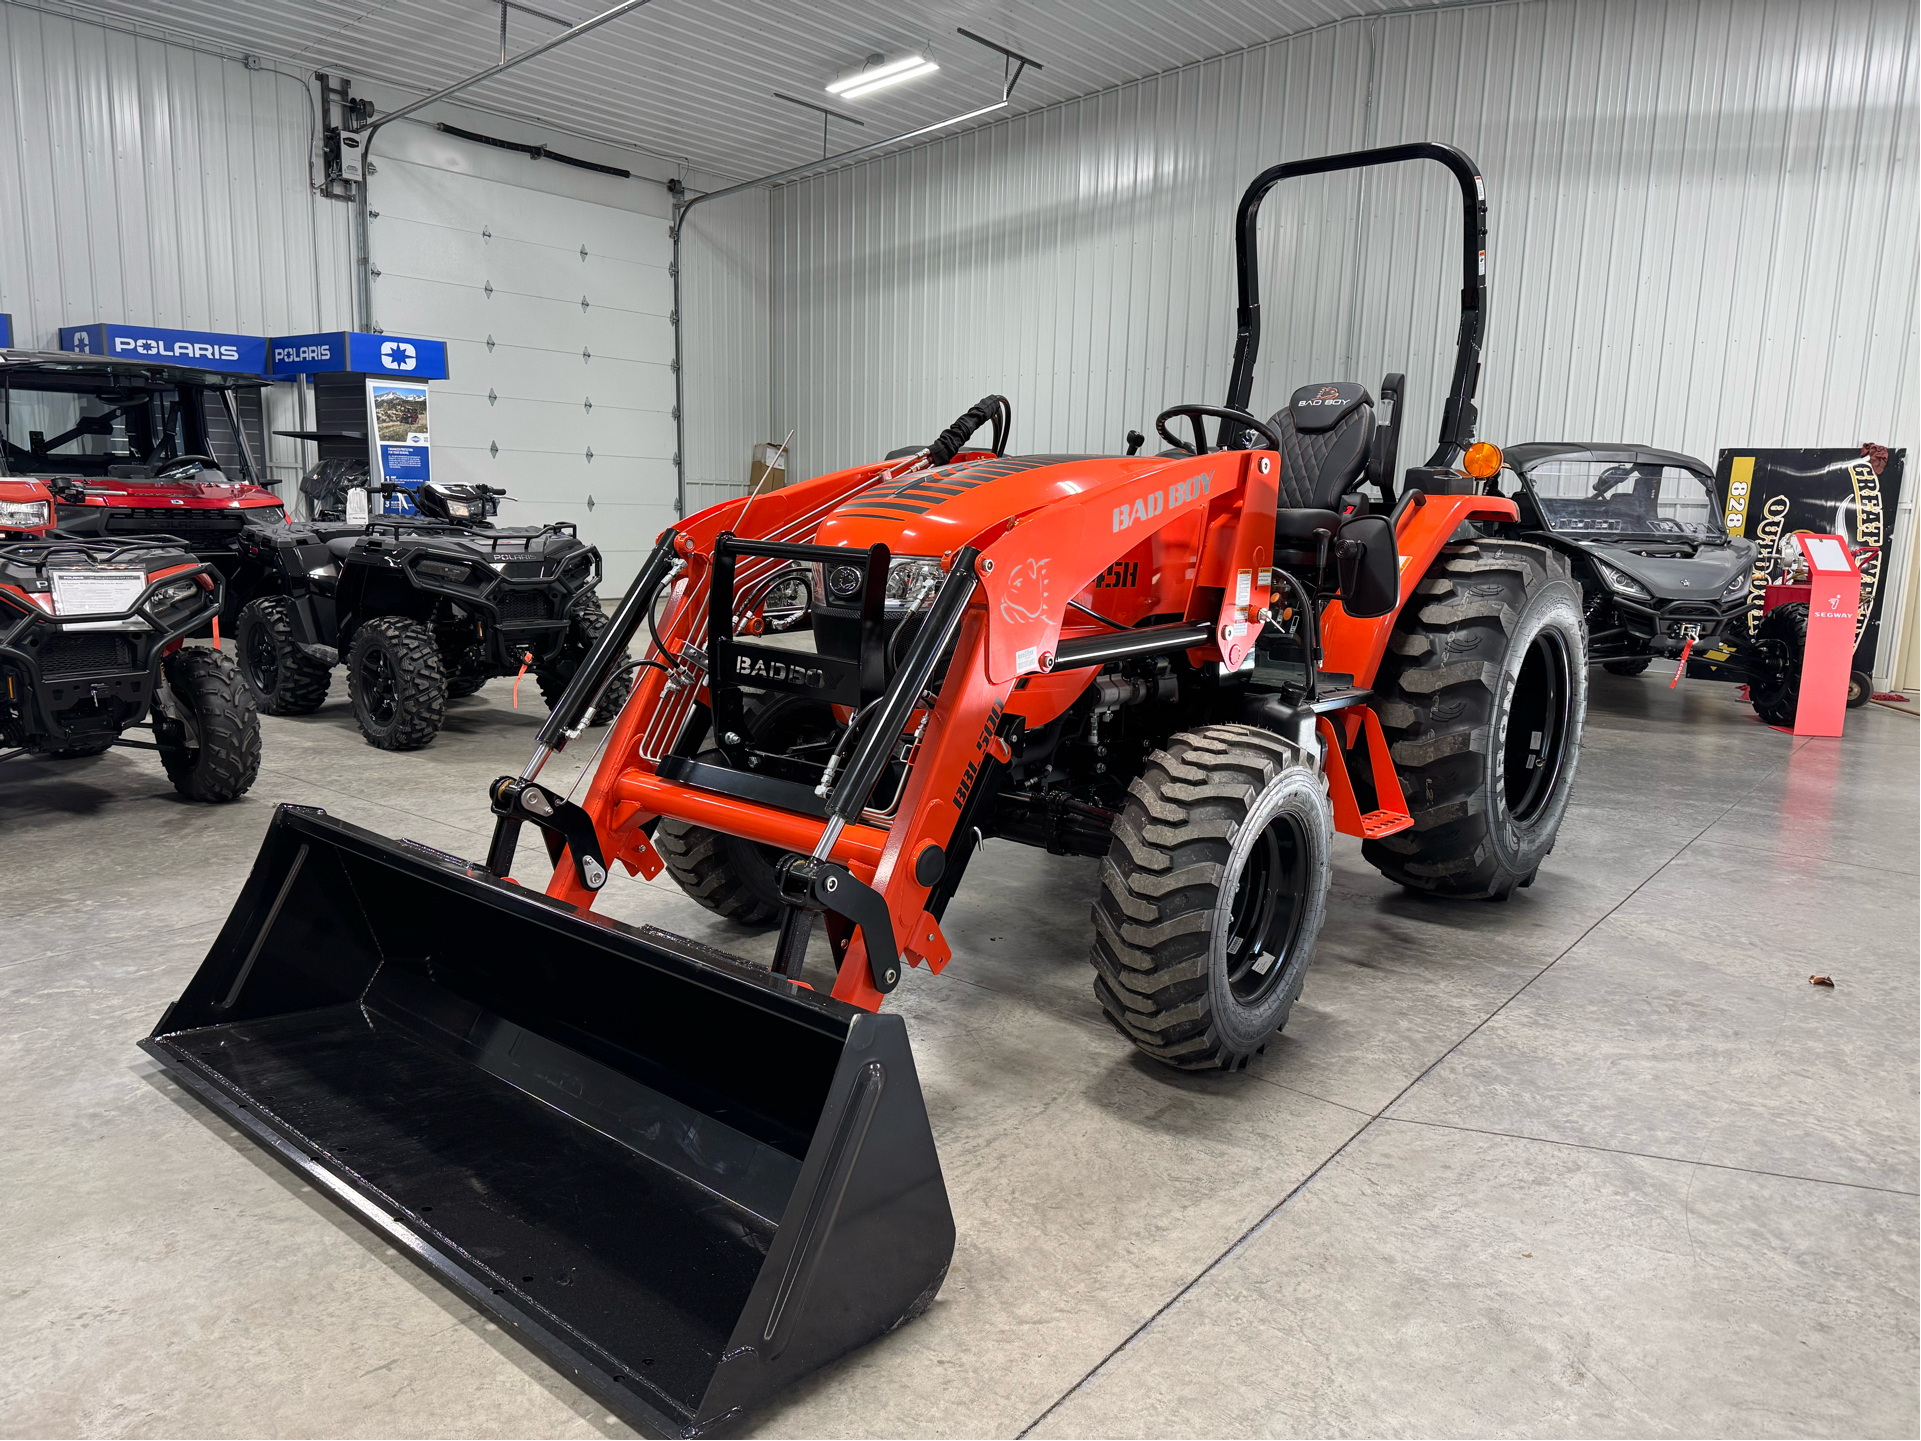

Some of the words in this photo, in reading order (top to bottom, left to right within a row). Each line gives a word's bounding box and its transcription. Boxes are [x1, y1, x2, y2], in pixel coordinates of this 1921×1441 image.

[114, 337, 239, 361] POLARIS
[275, 345, 331, 362] POLARIS
[1112, 490, 1163, 534] BAD
[1169, 469, 1215, 509] BOY
[1849, 461, 1883, 546] GREAT
[953, 760, 981, 810] BBL
[976, 697, 1004, 755] 500
